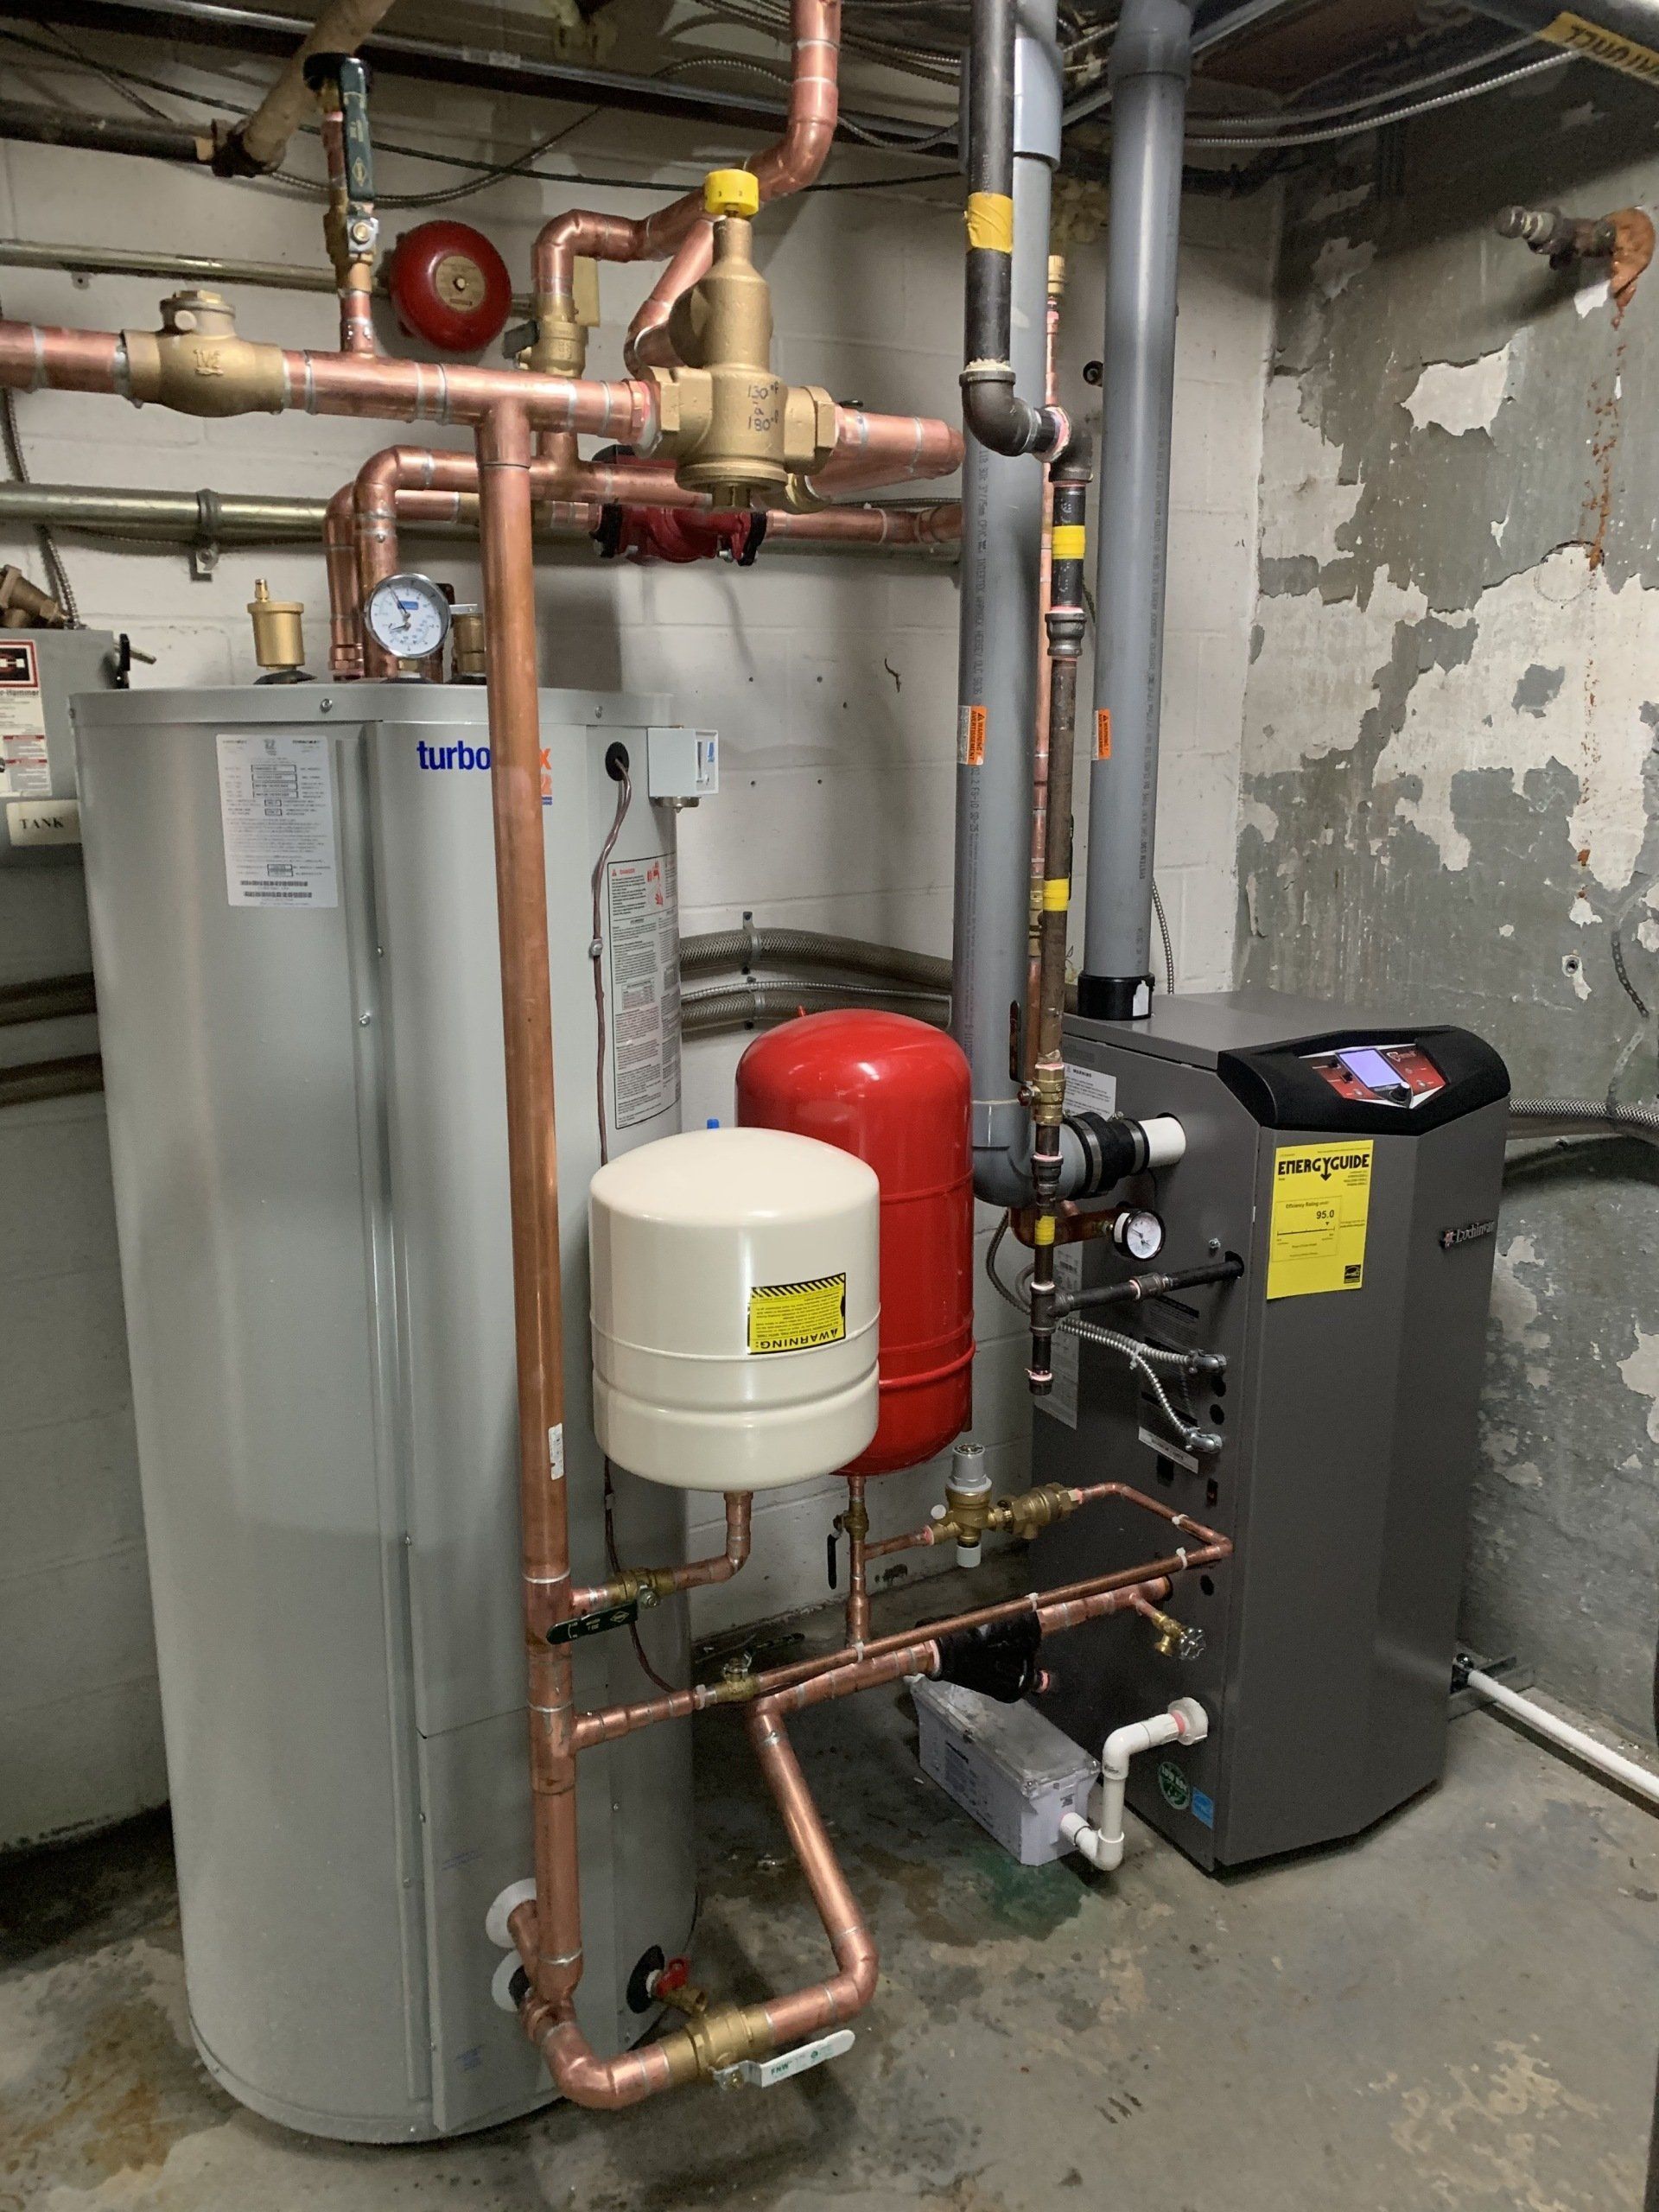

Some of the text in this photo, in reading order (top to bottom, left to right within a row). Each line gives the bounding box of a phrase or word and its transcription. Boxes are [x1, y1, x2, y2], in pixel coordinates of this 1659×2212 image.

[969, 710, 977, 761] AVERTISSEMENT
[18, 817, 65, 830] TANK
[1278, 1154, 1370, 1179] ENERGYGUIDE
[1316, 1210, 1335, 1219] 95.0
[755, 1331, 830, 1349] WARNING:
